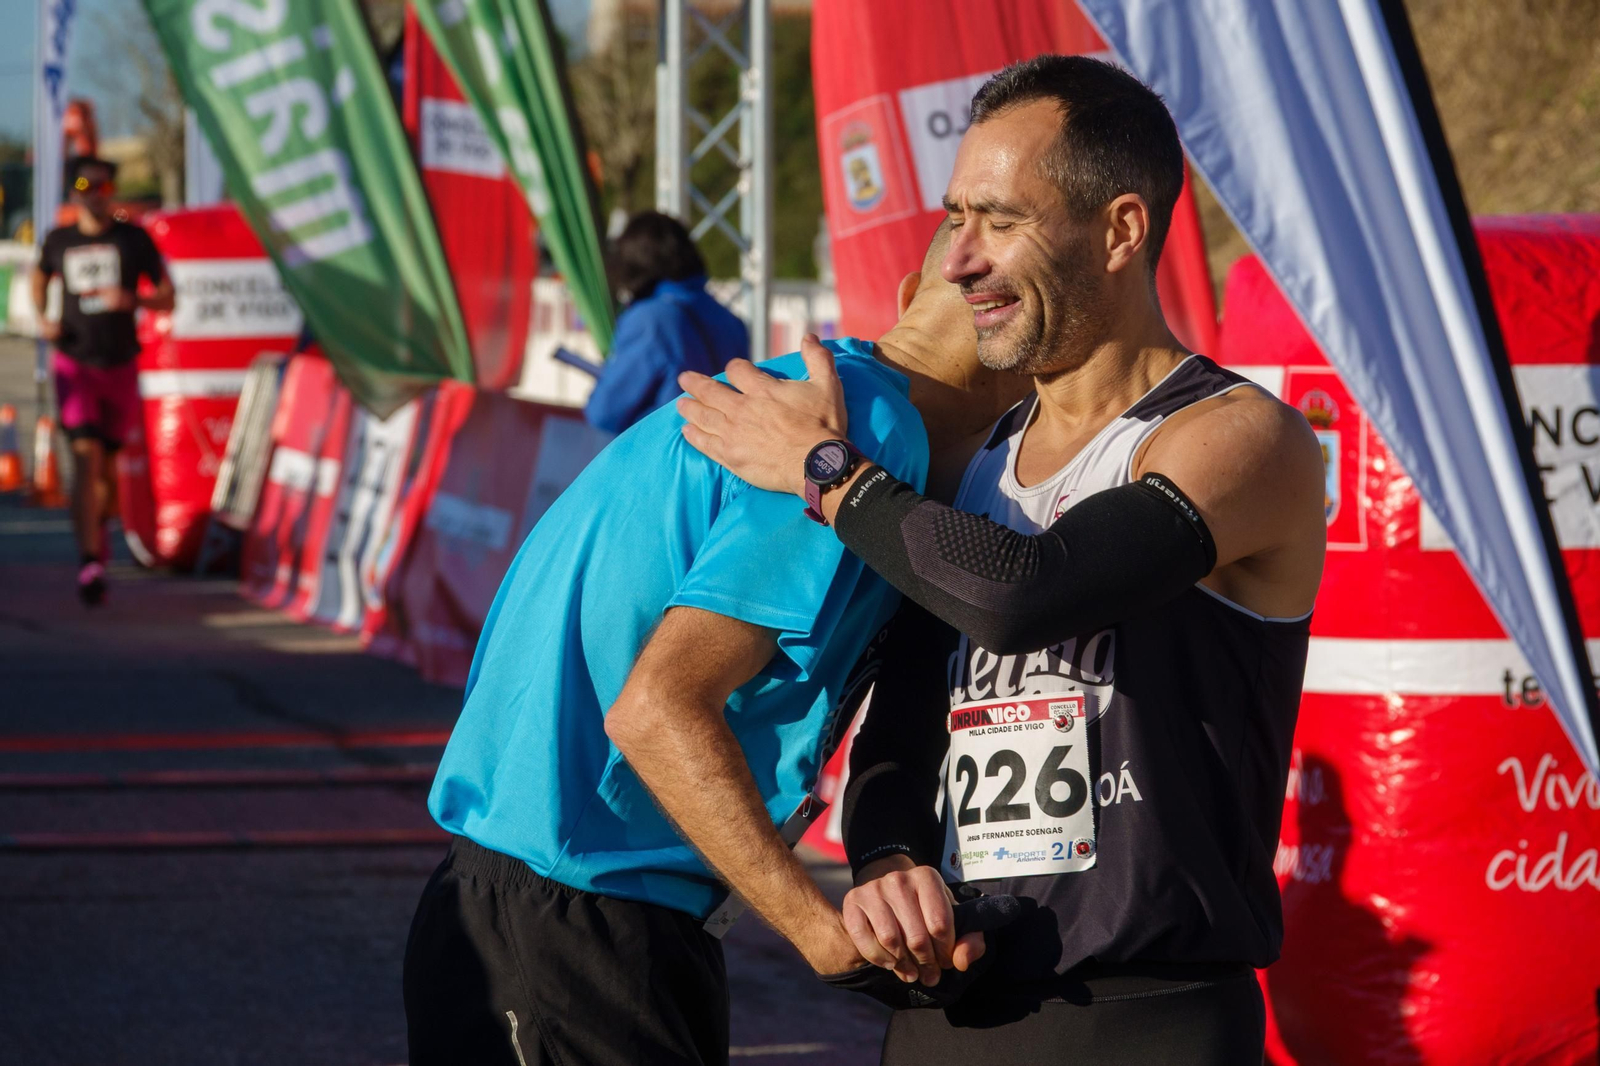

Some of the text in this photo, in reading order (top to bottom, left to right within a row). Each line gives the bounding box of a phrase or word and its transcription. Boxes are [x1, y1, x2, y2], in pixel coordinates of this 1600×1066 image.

[968, 722, 1045, 737] MILLA CIDADE DE VIGO
[956, 745, 1088, 828] 226
[981, 829, 1024, 840] FERNANDEZ
[1025, 826, 1064, 837] SOENGAS
[1007, 849, 1047, 859] DEPORTE
[1485, 832, 1600, 893] cida
